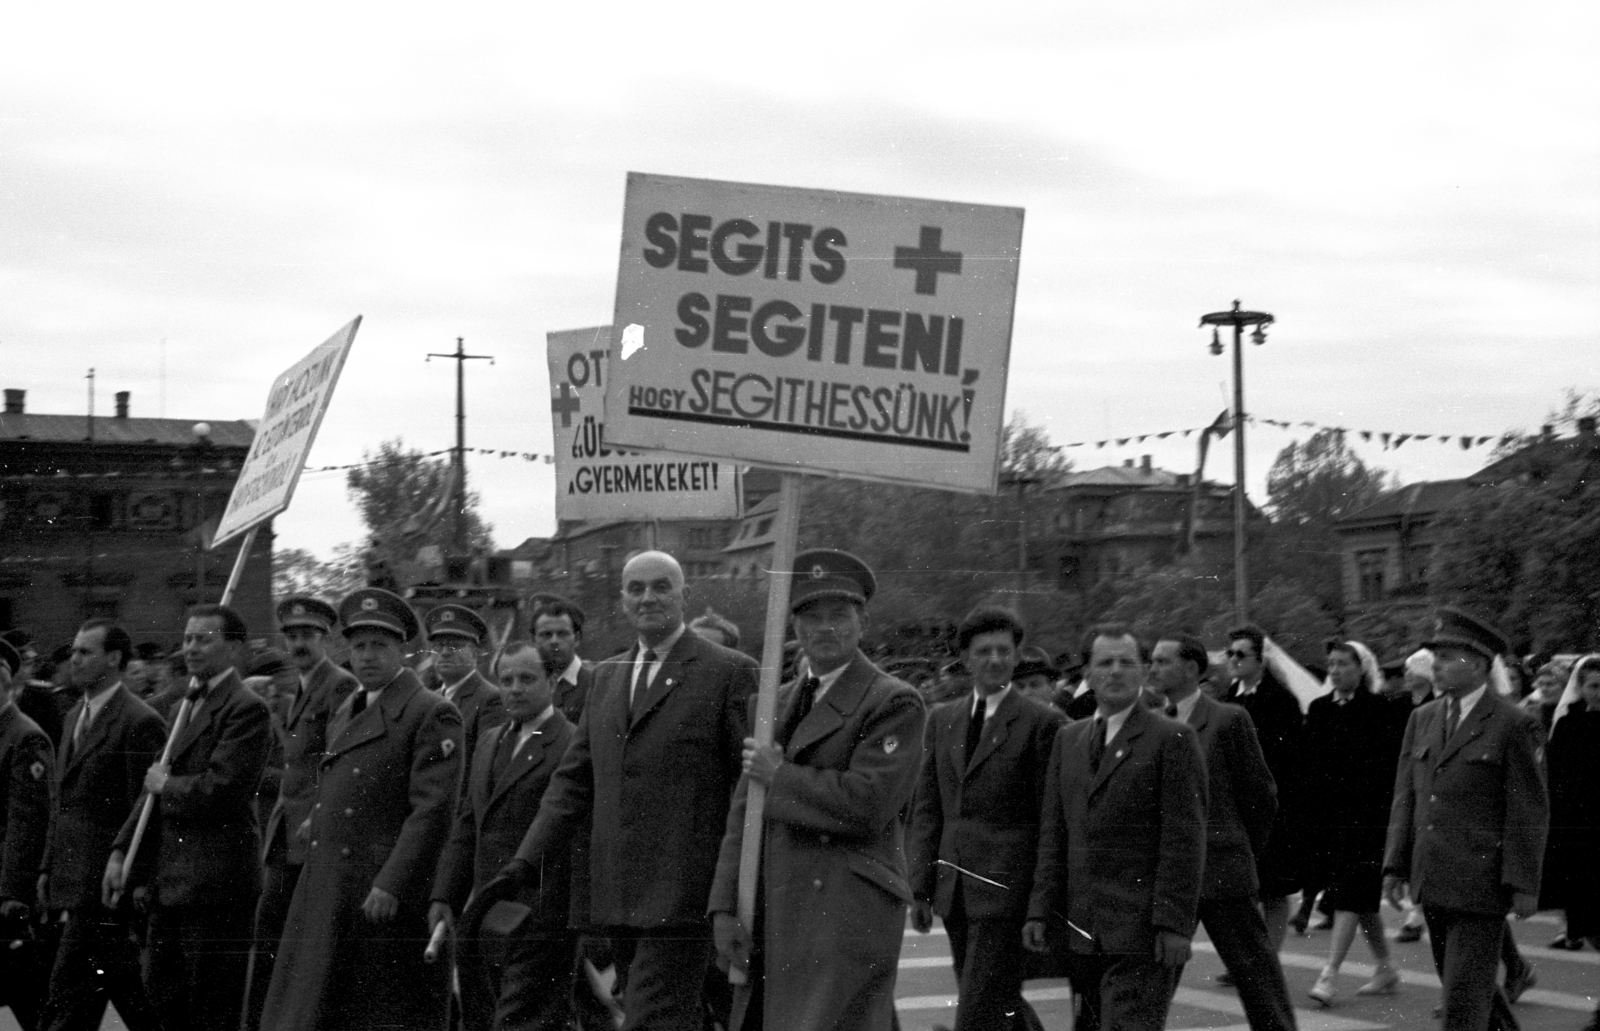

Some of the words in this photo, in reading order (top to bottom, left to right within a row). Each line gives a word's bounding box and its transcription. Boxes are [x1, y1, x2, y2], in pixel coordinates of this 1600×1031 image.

[643, 212, 848, 284] SEGITS
[567, 350, 610, 388] OT
[675, 292, 979, 385] SEGITENI,
[629, 385, 687, 411] HOGY
[688, 368, 976, 443] SEGITHESSÜNK!
[568, 481, 575, 495] A
[576, 462, 719, 493] GYERMEKEKET!
